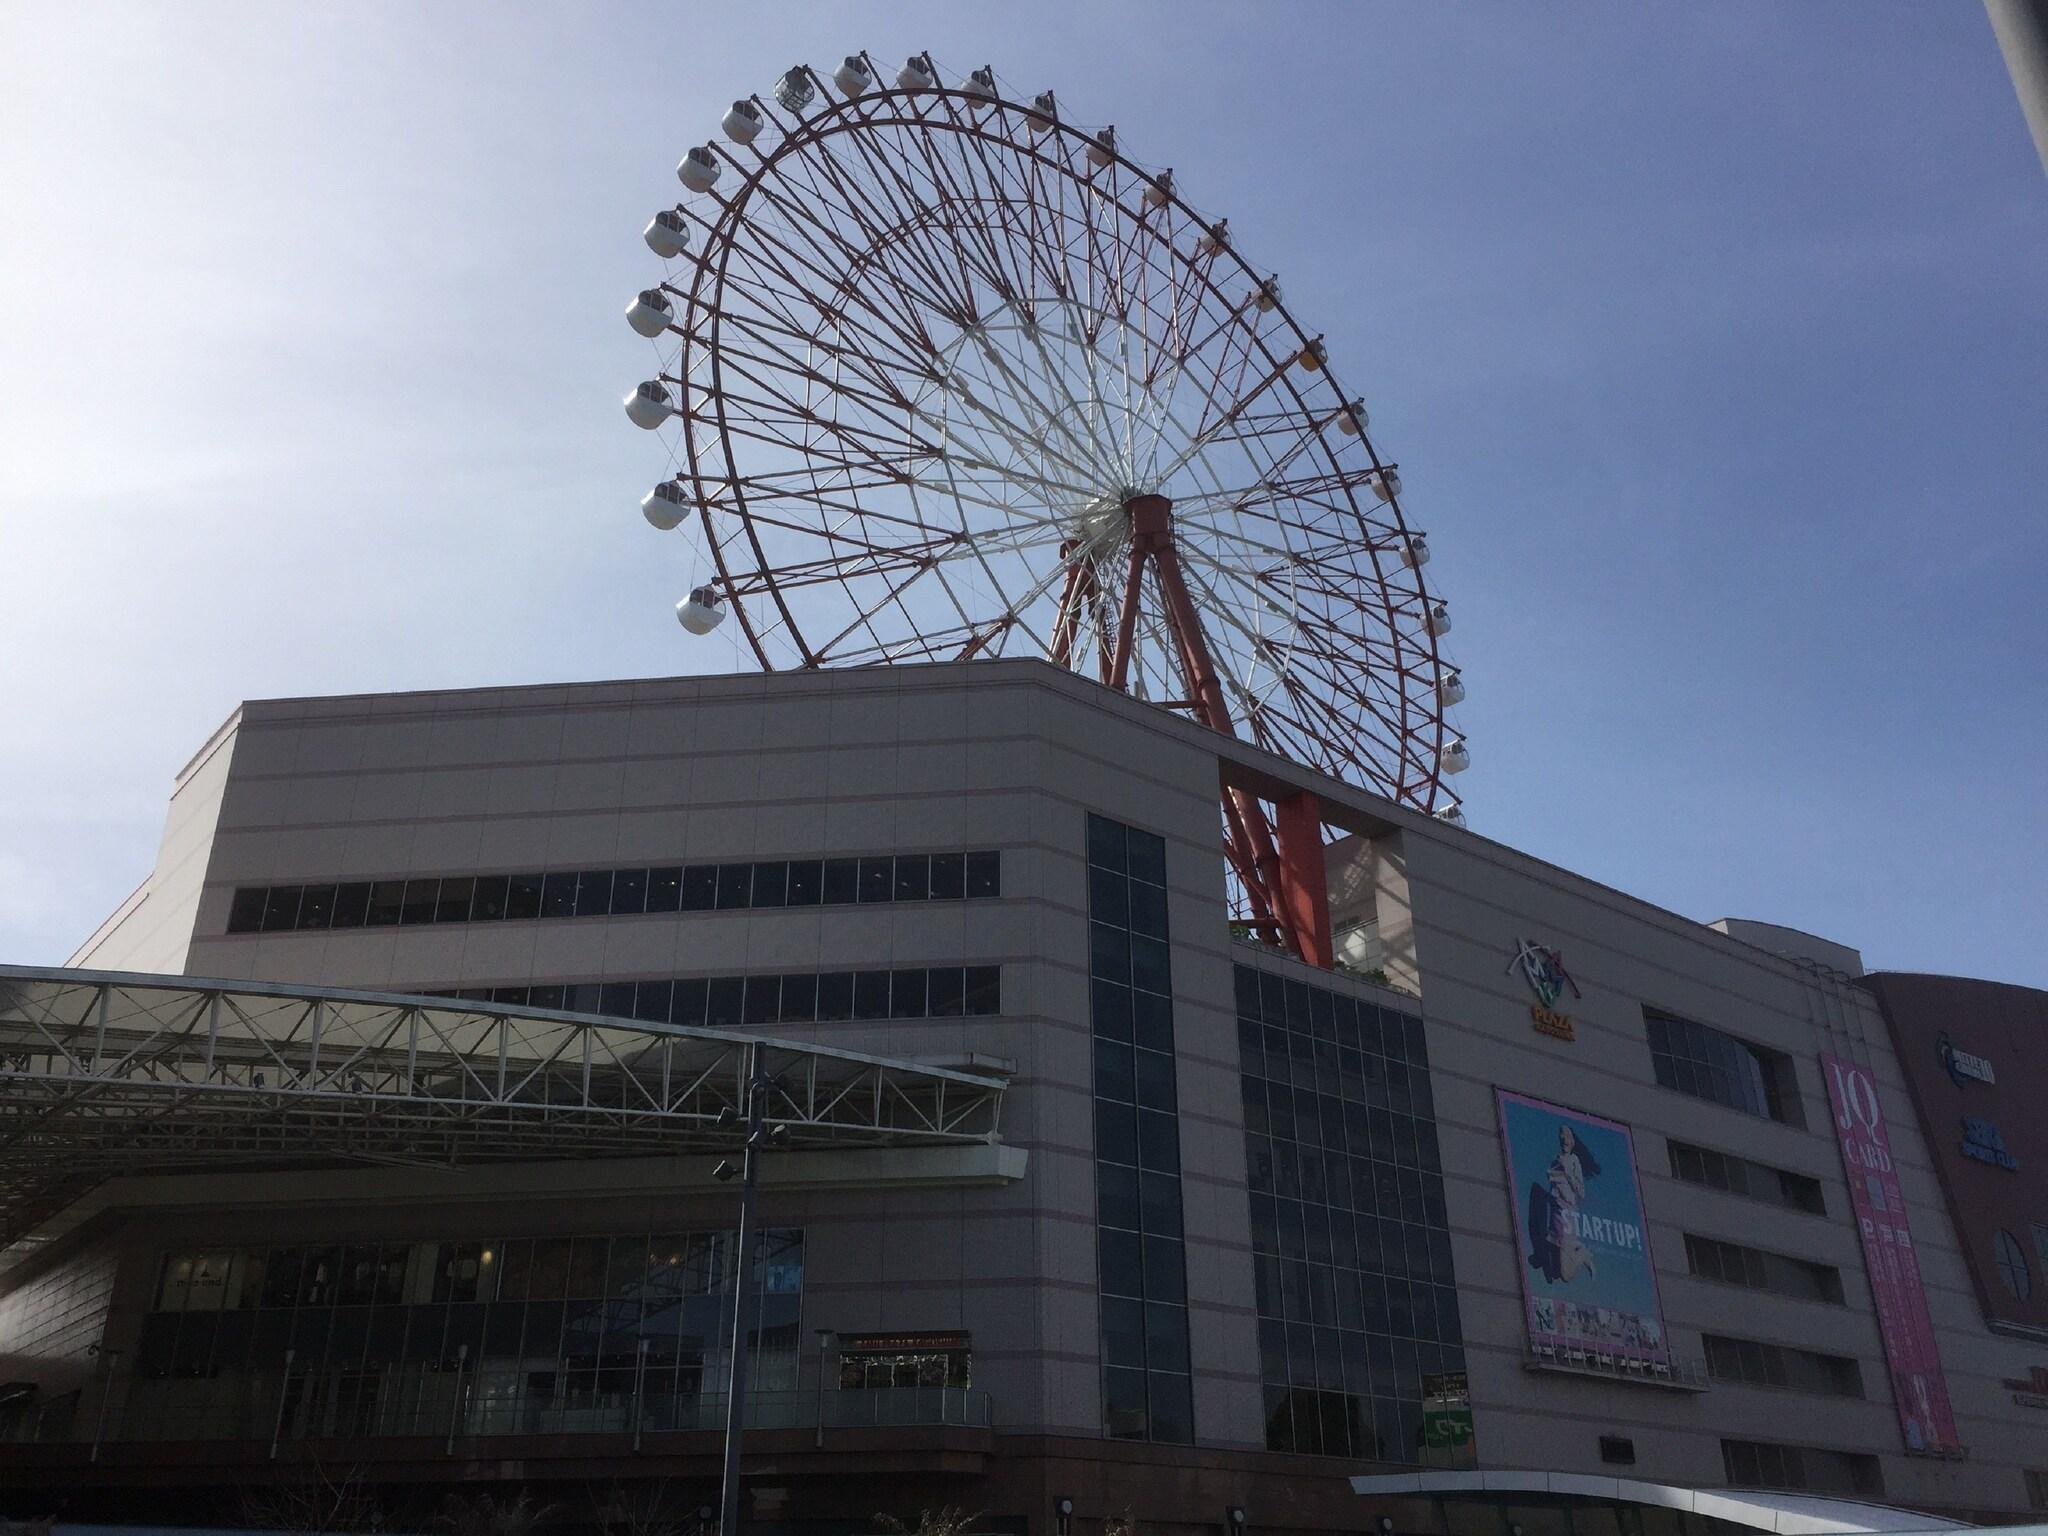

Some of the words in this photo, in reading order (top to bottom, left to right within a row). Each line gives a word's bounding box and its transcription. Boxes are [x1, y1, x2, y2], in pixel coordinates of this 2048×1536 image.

[1531, 1007, 1573, 1032] PLAZA
[1829, 1063, 1883, 1146] JQ
[1845, 1137, 1891, 1173] CARD
[1560, 1209, 1642, 1251] STARTUP!
